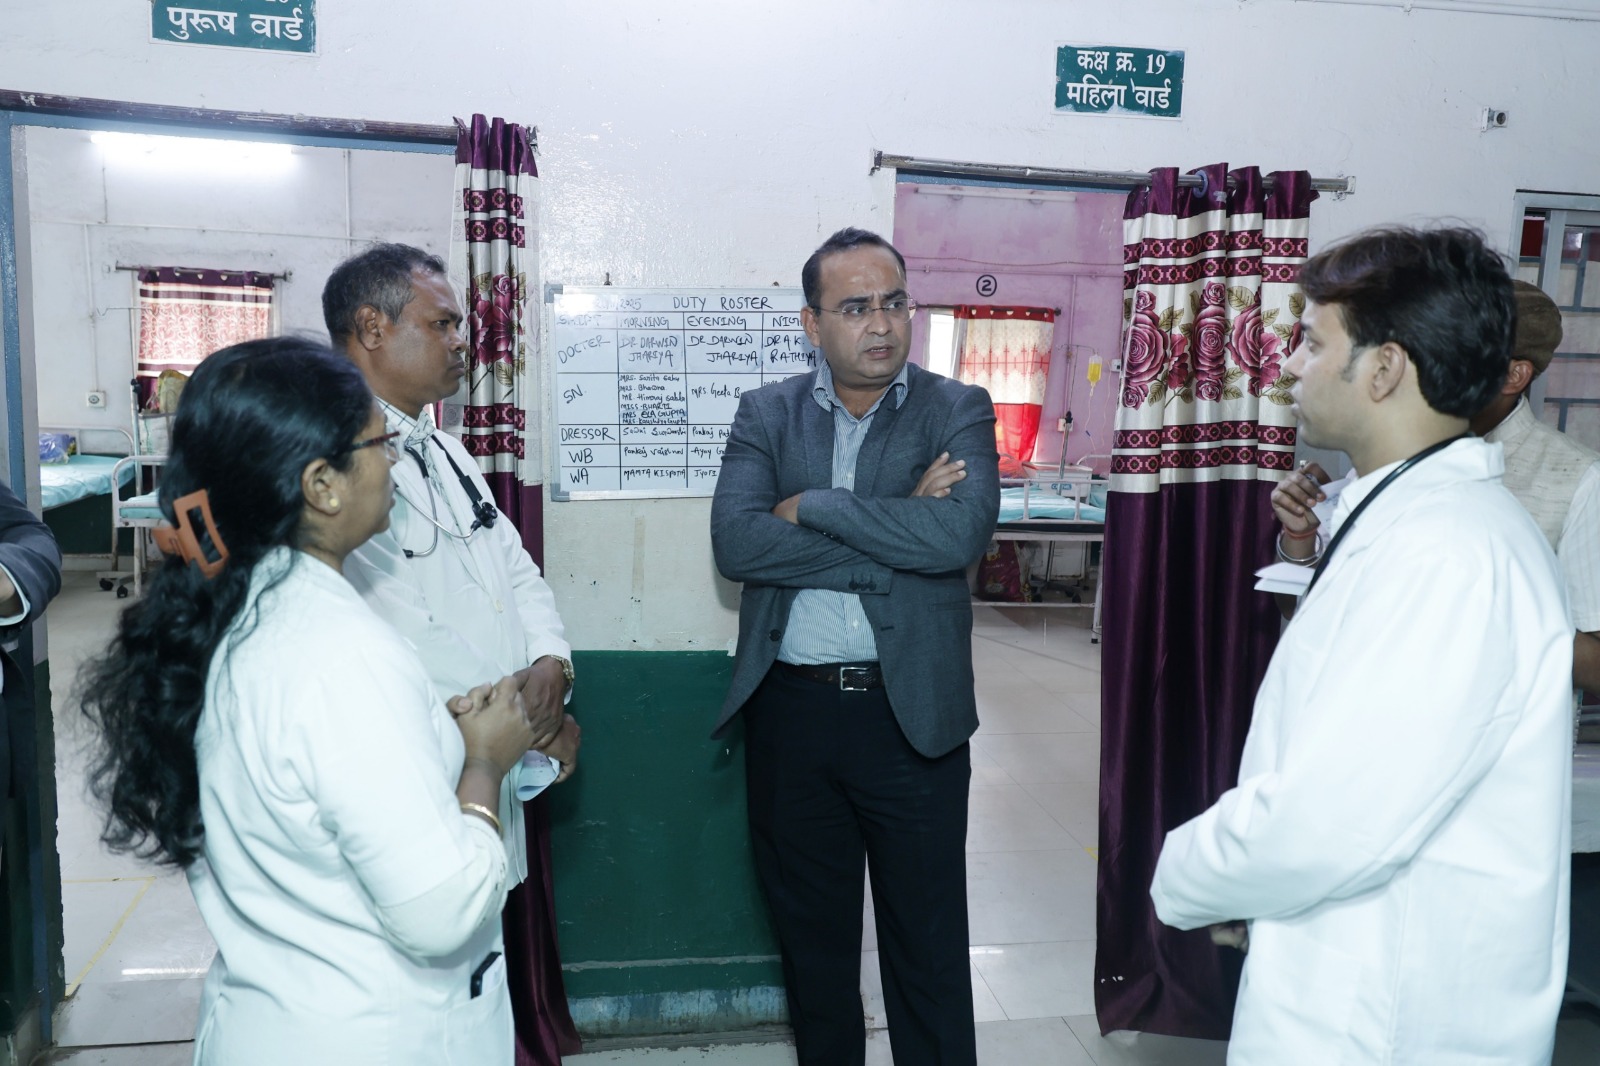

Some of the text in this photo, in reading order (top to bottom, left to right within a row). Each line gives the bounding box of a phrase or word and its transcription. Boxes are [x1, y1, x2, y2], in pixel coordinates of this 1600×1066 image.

[167, 7, 303, 41] पुरूष वार्ड
[1077, 50, 1165, 74] कक्ष क्र. 19
[1066, 74, 1171, 109] महिला वार्ड
[673, 296, 706, 312] DUTY
[720, 296, 773, 310] ROSTER
[620, 316, 669, 330] MORNING
[687, 315, 746, 330] EVENING
[557, 335, 610, 364] DOCTER
[563, 384, 583, 404] SN
[561, 427, 616, 442] DRESSOR
[568, 447, 594, 464] WB
[570, 467, 589, 485] WA
